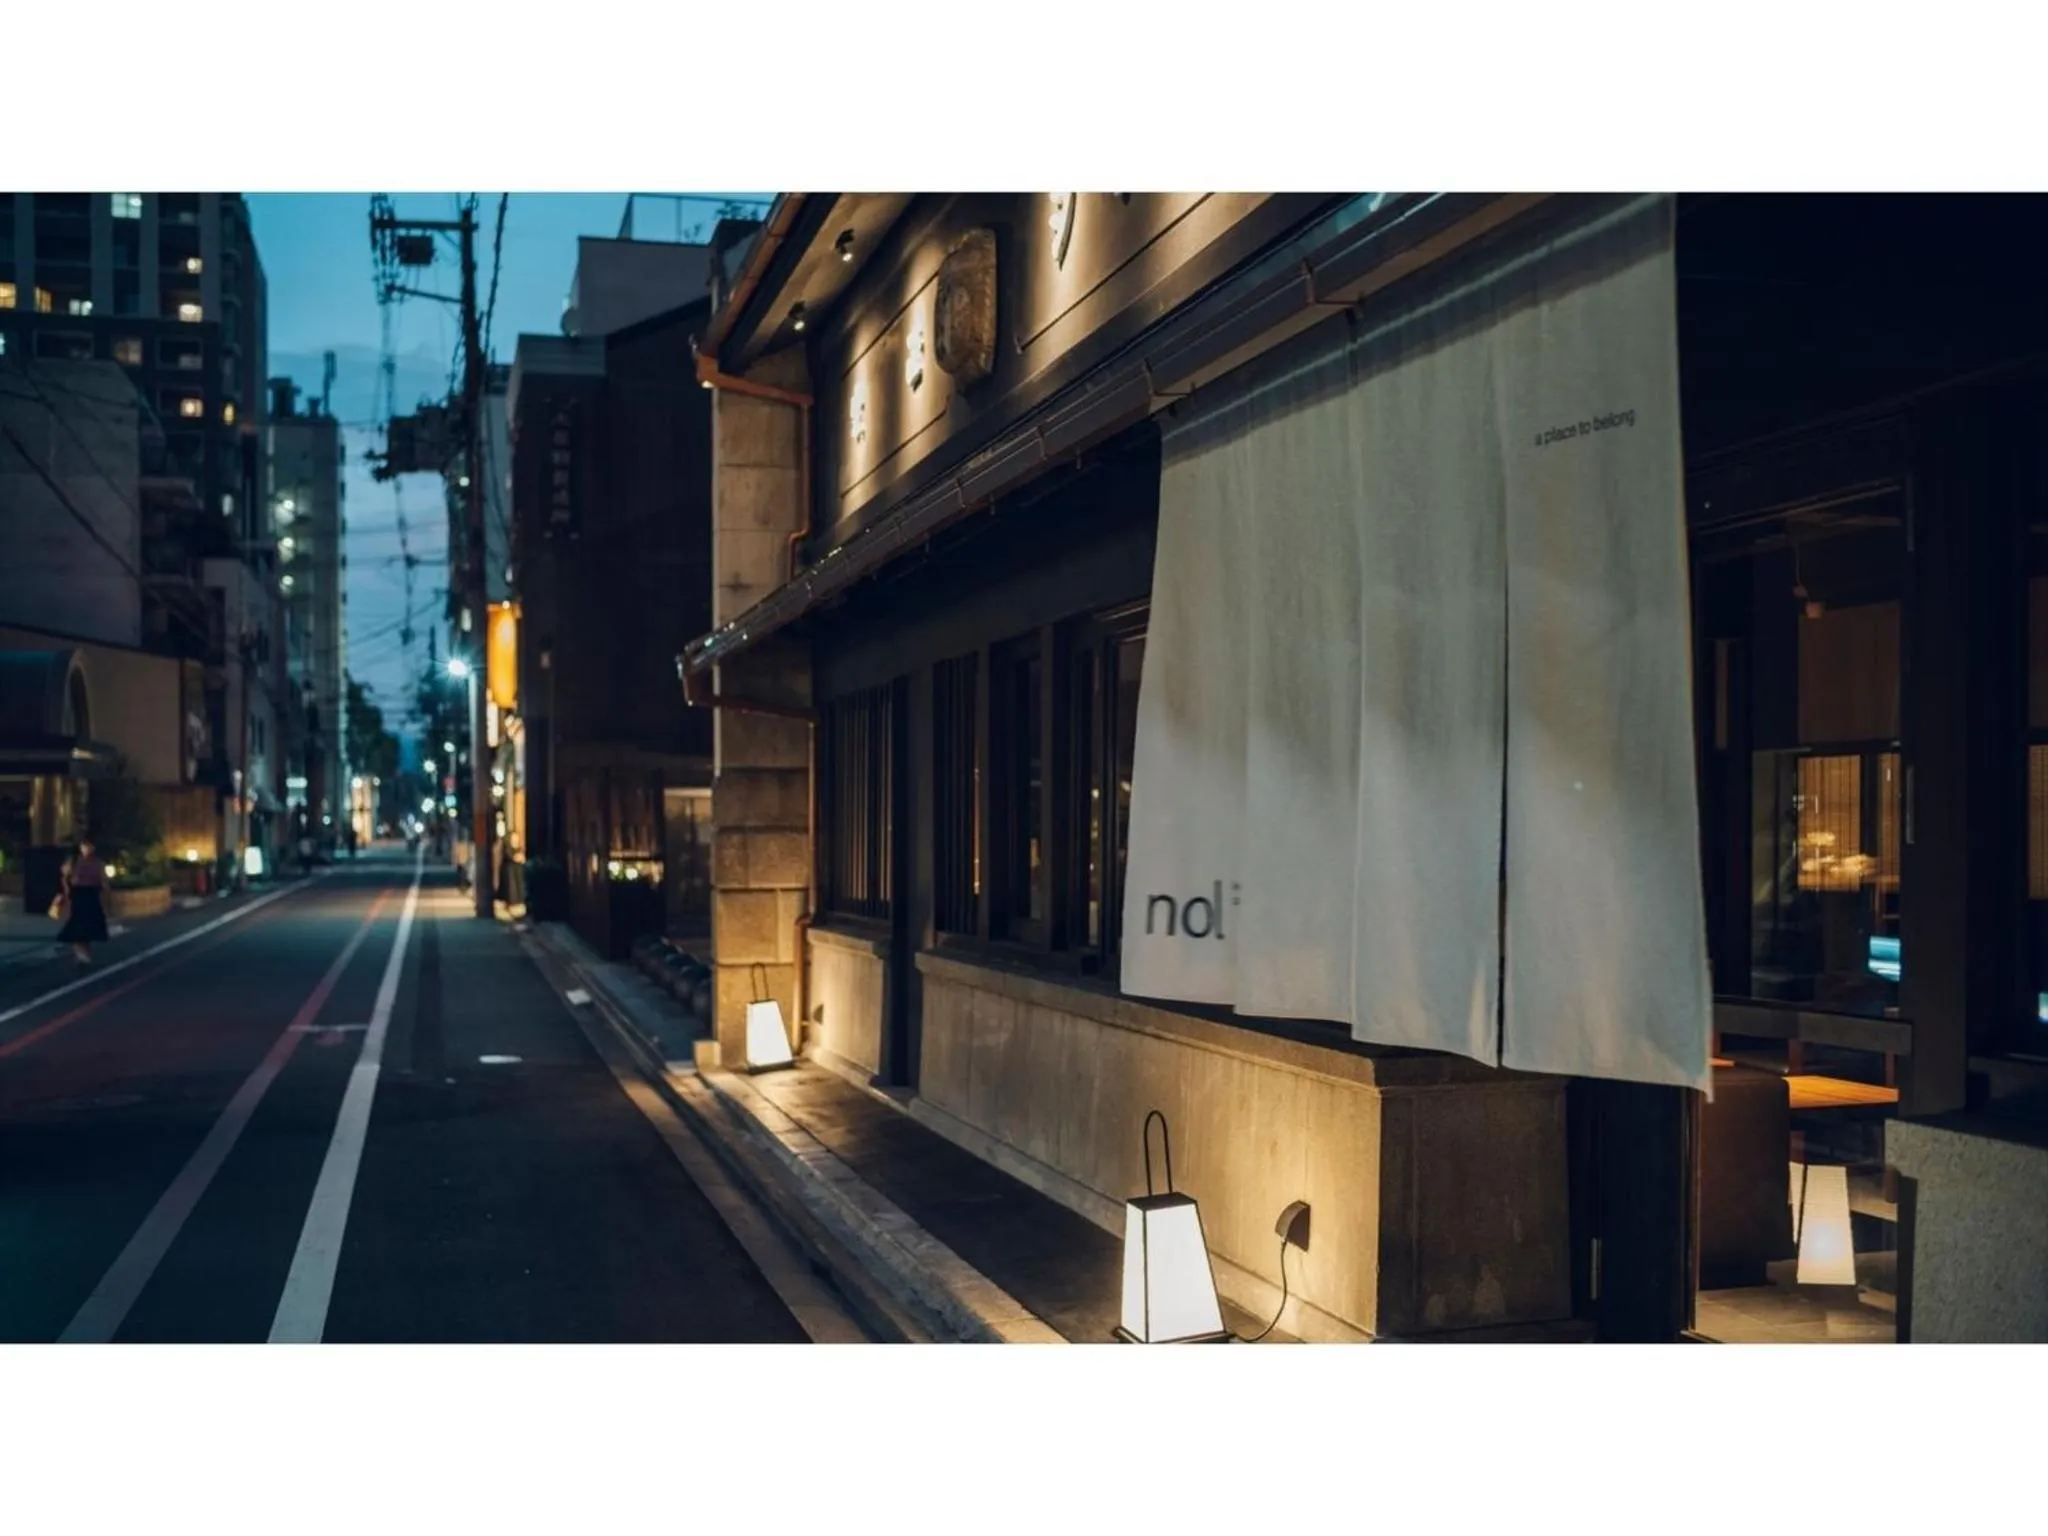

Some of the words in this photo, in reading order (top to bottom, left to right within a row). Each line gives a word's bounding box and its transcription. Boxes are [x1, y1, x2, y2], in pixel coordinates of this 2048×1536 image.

[1544, 425, 1577, 445] place
[1578, 420, 1591, 436] to
[1593, 409, 1635, 432] belong
